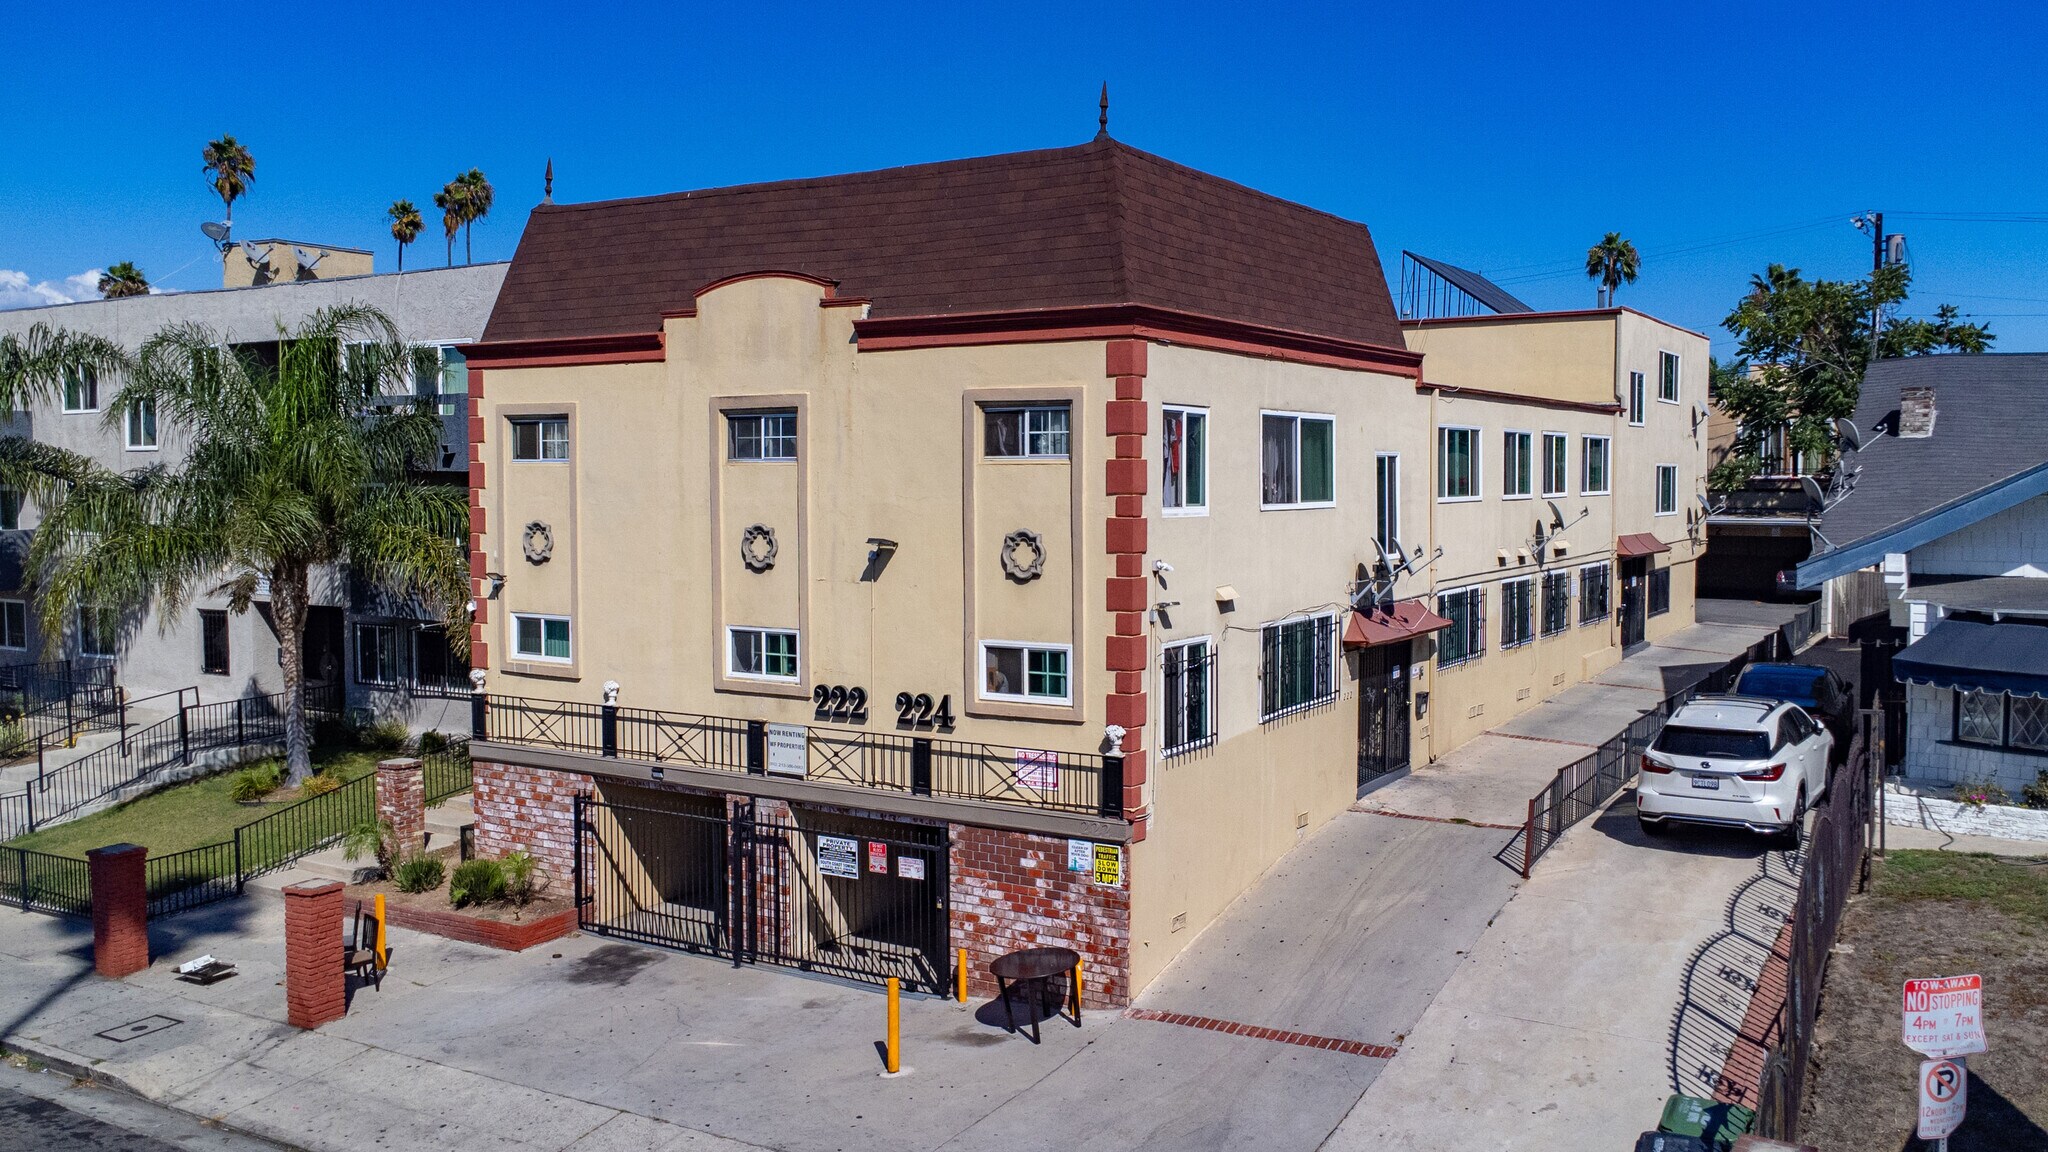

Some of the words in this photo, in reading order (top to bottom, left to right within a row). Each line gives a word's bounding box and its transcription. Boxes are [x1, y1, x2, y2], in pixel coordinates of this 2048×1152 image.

[814, 684, 868, 720] 222
[896, 692, 956, 729] 224
[782, 730, 805, 738] RENTING
[777, 742, 805, 750] PROPERTIES
[1025, 752, 1056, 761] TRESPASSNG
[1081, 822, 1108, 836] 222
[823, 842, 853, 851] PROPERTY
[1096, 872, 1101, 883] 5
[1102, 873, 1118, 885] MPH
[1914, 977, 1973, 990] TOW-AWAY
[1907, 991, 1928, 1011] NO
[1932, 990, 1978, 1010] STOPPING
[1912, 1016, 1936, 1030] 4PM
[1955, 1012, 1974, 1027] 7PM
[1906, 1034, 1938, 1042] EXCEPT
[1942, 1033, 1954, 1042] SAT
[1964, 1030, 1981, 1040] SUN
